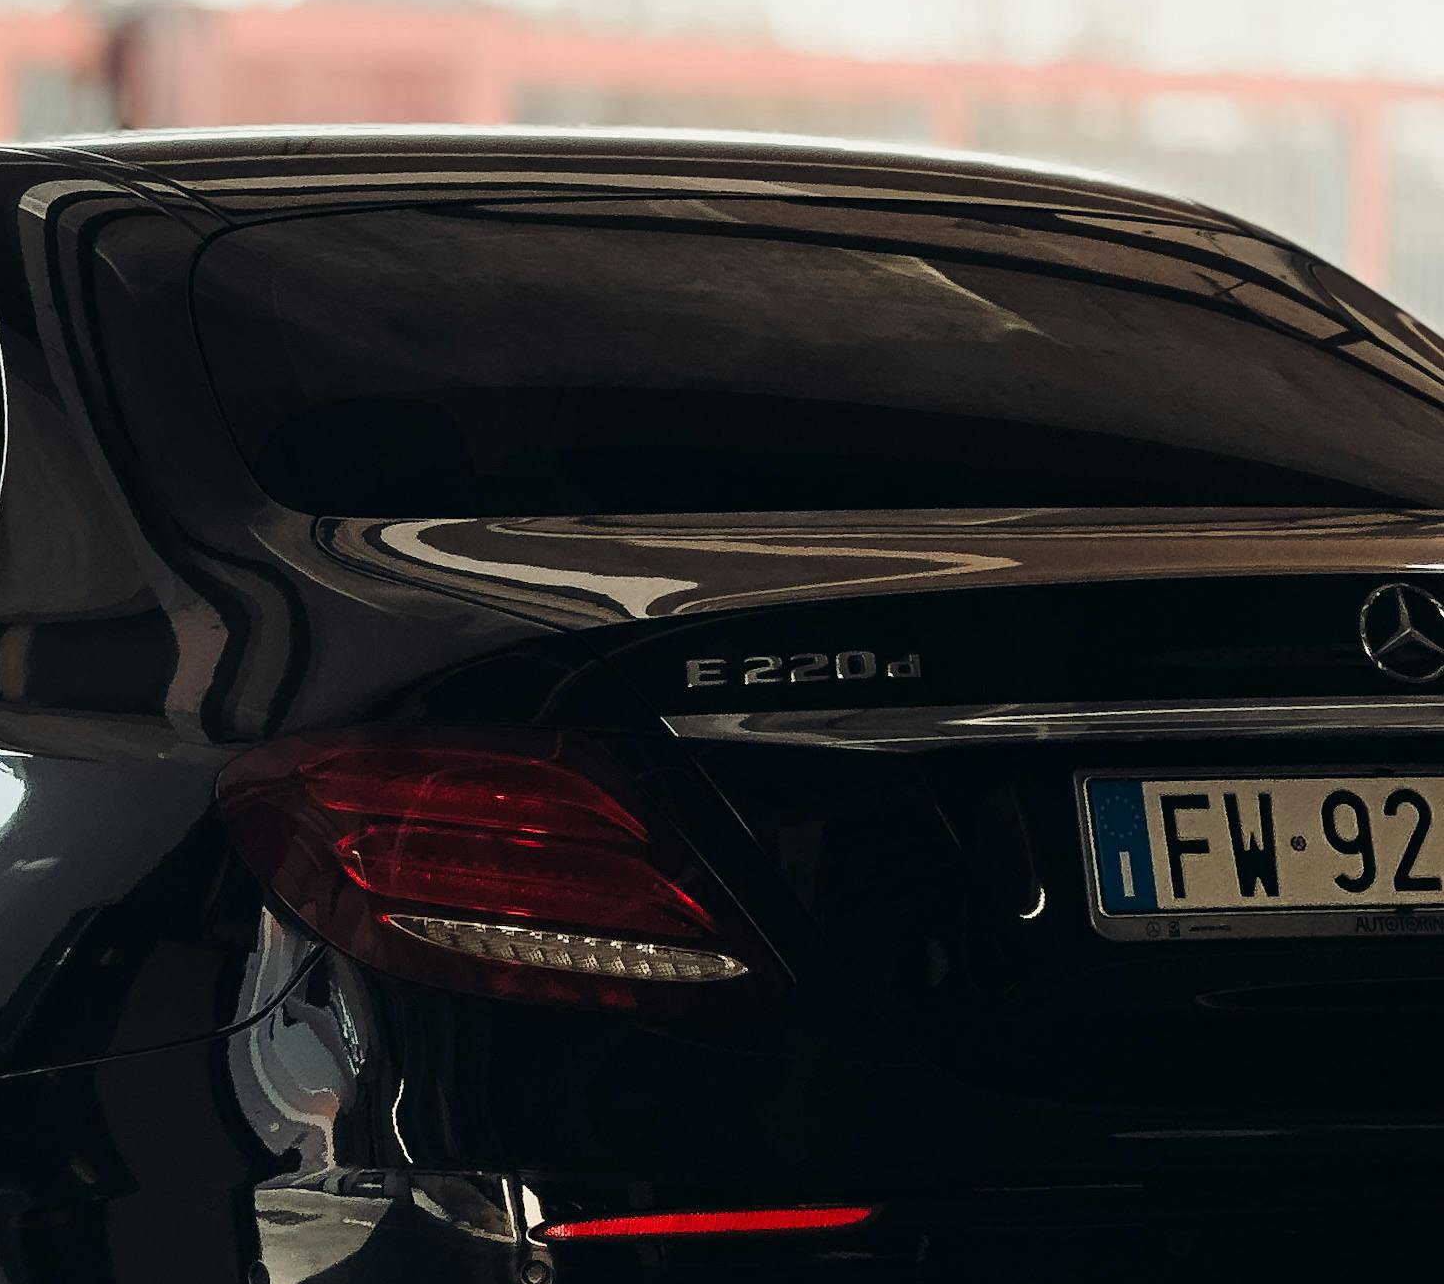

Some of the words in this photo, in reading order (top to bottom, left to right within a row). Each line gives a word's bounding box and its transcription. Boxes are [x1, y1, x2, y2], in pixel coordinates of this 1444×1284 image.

[686, 657, 729, 688] E
[743, 650, 877, 685] 220
[887, 653, 921, 677] d
[1160, 791, 1281, 899] FW
[1320, 788, 1442, 894] 92
[1120, 851, 1135, 897] I
